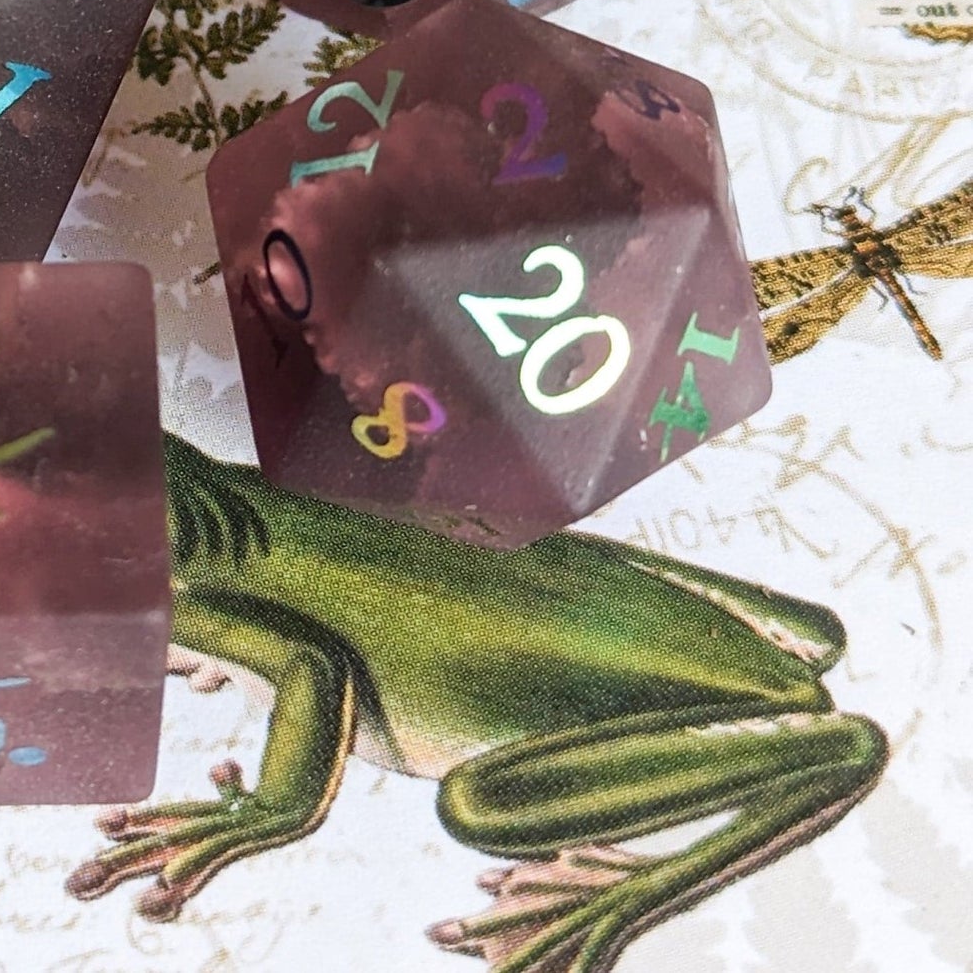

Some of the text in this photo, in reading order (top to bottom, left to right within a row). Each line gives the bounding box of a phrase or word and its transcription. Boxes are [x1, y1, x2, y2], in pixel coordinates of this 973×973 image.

[289, 70, 404, 187] 12
[480, 84, 568, 185] 2
[458, 244, 632, 416] 20
[351, 382, 447, 460] 8
